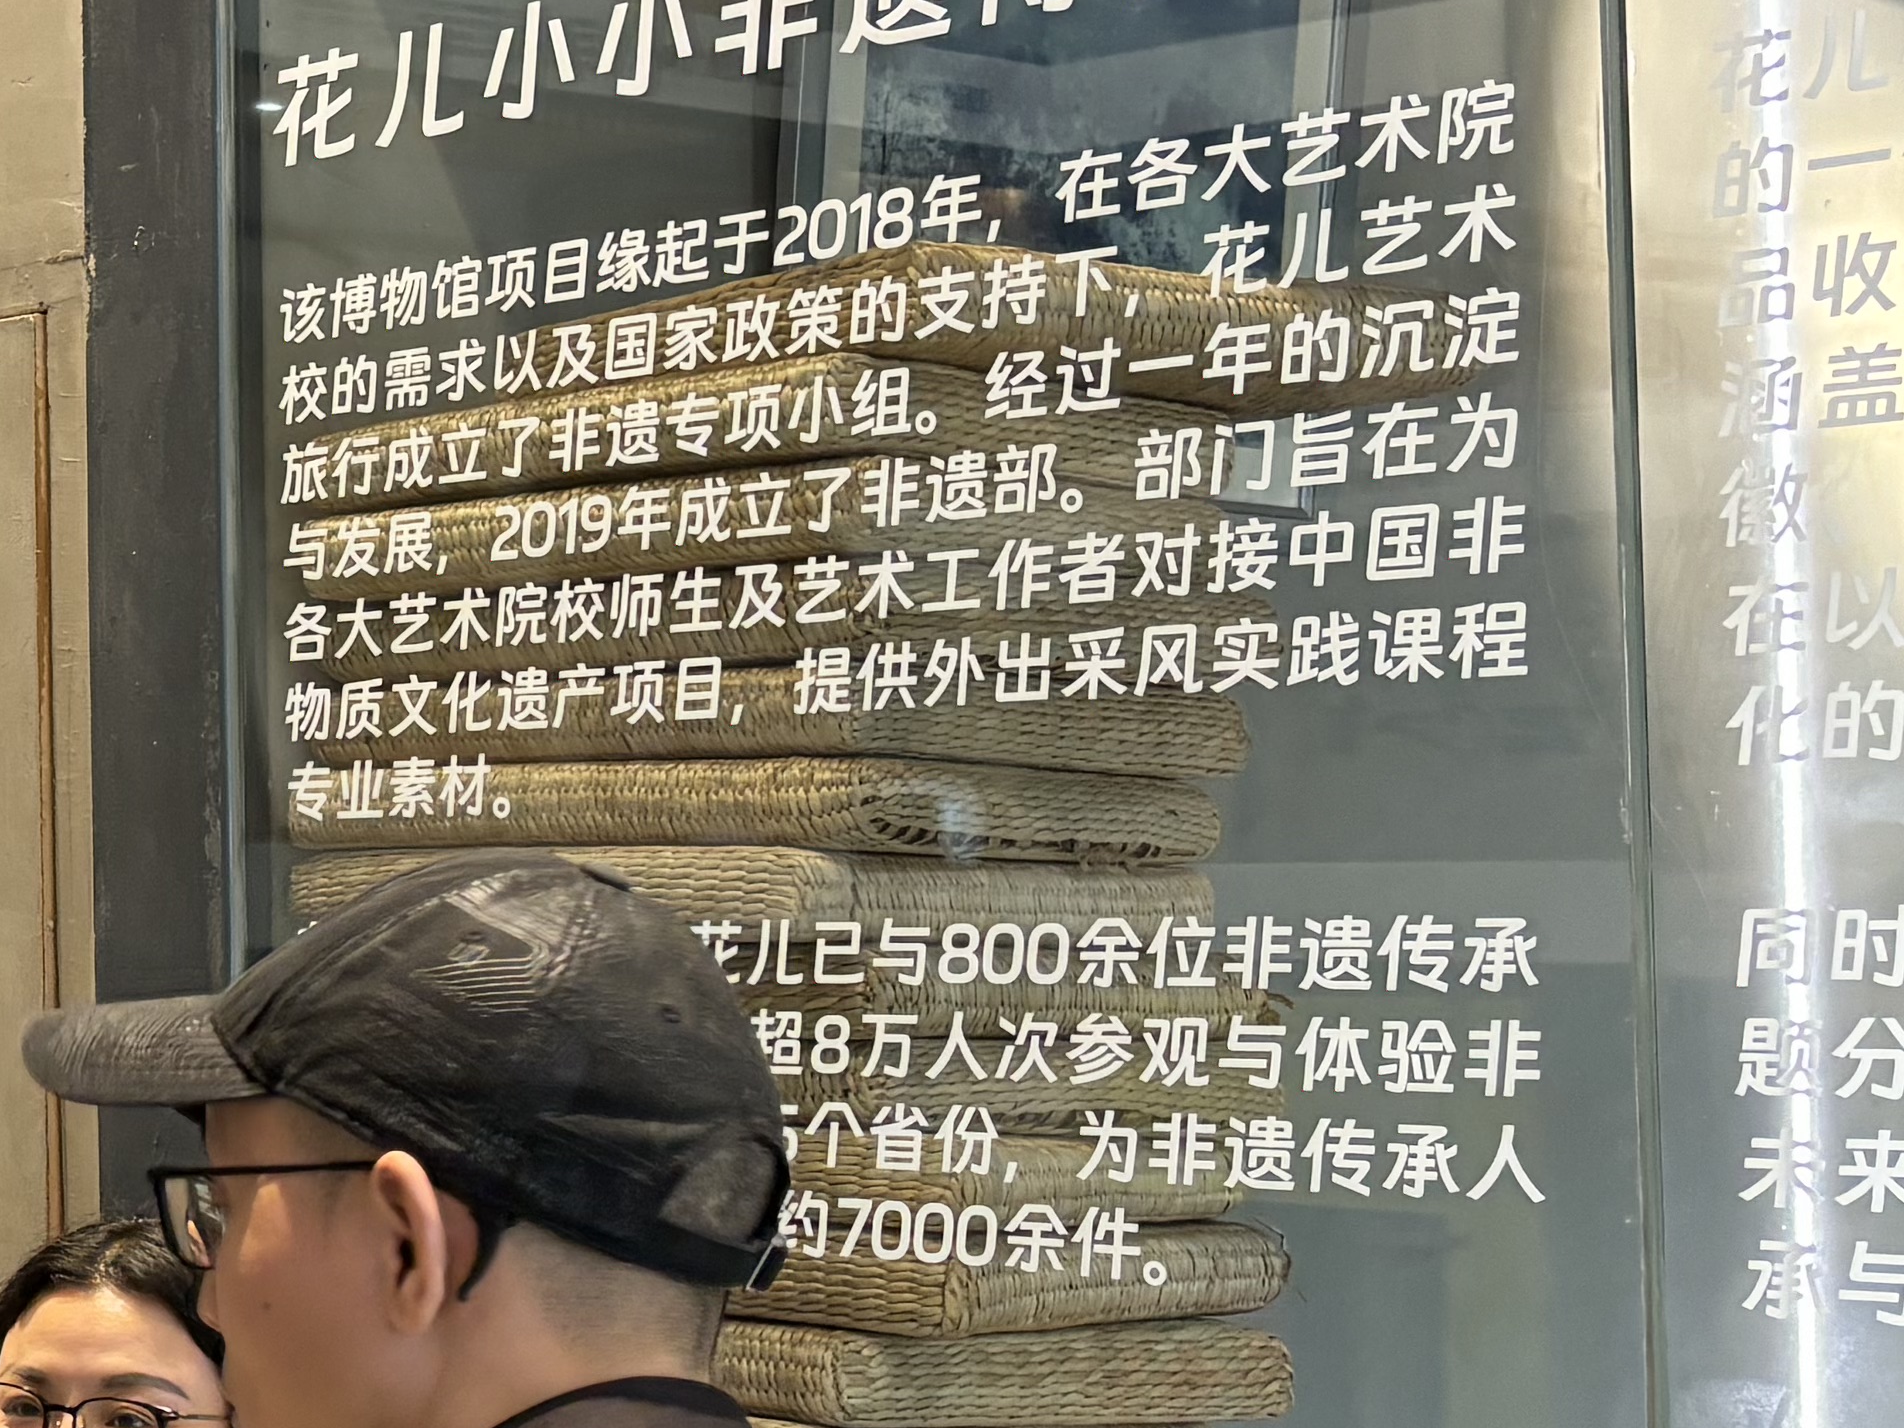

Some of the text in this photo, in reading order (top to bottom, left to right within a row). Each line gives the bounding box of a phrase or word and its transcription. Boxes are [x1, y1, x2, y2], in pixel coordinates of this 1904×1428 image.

[280, 79, 1517, 346] 该博物馆项目缘起于2018年，在各大艺术院
[280, 184, 1517, 427] 校的需求以及国家政策的支持下，花儿艺术
[281, 288, 1522, 506] 旅行成立了非遗专项小组。经过一年的沉淀
[283, 394, 1521, 581] 与发展，2019年成立了非遗部。部门旨在为
[283, 498, 1529, 664] 各大艺术院校师生及艺术工作者对接中国非
[284, 602, 1530, 744] 物质文化遗产项目，提供外出采风实践课程
[287, 759, 517, 825] 专业素材。
[1735, 904, 1903, 988] 同时
[750, 1008, 1542, 1100] 超8万人次参观与体验非
[1733, 1016, 1903, 1101] 题分
[1737, 1127, 1903, 1215] 未来
[777, 1188, 1171, 1290] 约7000余件。
[1741, 1239, 1903, 1328] 承与
